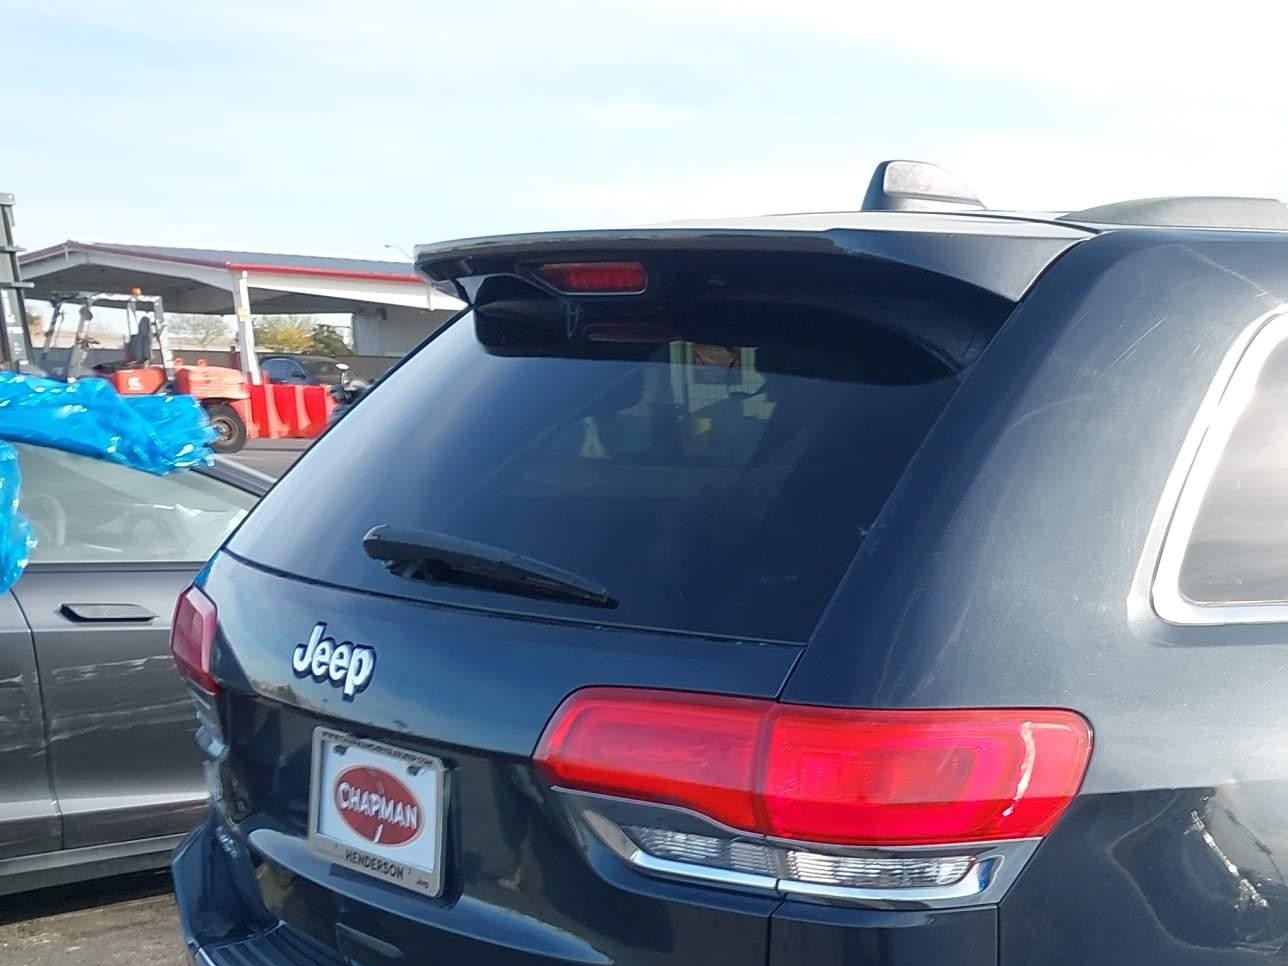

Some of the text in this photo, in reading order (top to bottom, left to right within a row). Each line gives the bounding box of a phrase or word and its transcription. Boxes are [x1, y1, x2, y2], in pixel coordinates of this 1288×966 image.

[292, 621, 376, 702] Jeep
[337, 782, 418, 830] CHAPMAN
[345, 849, 404, 879] HENDERSON
